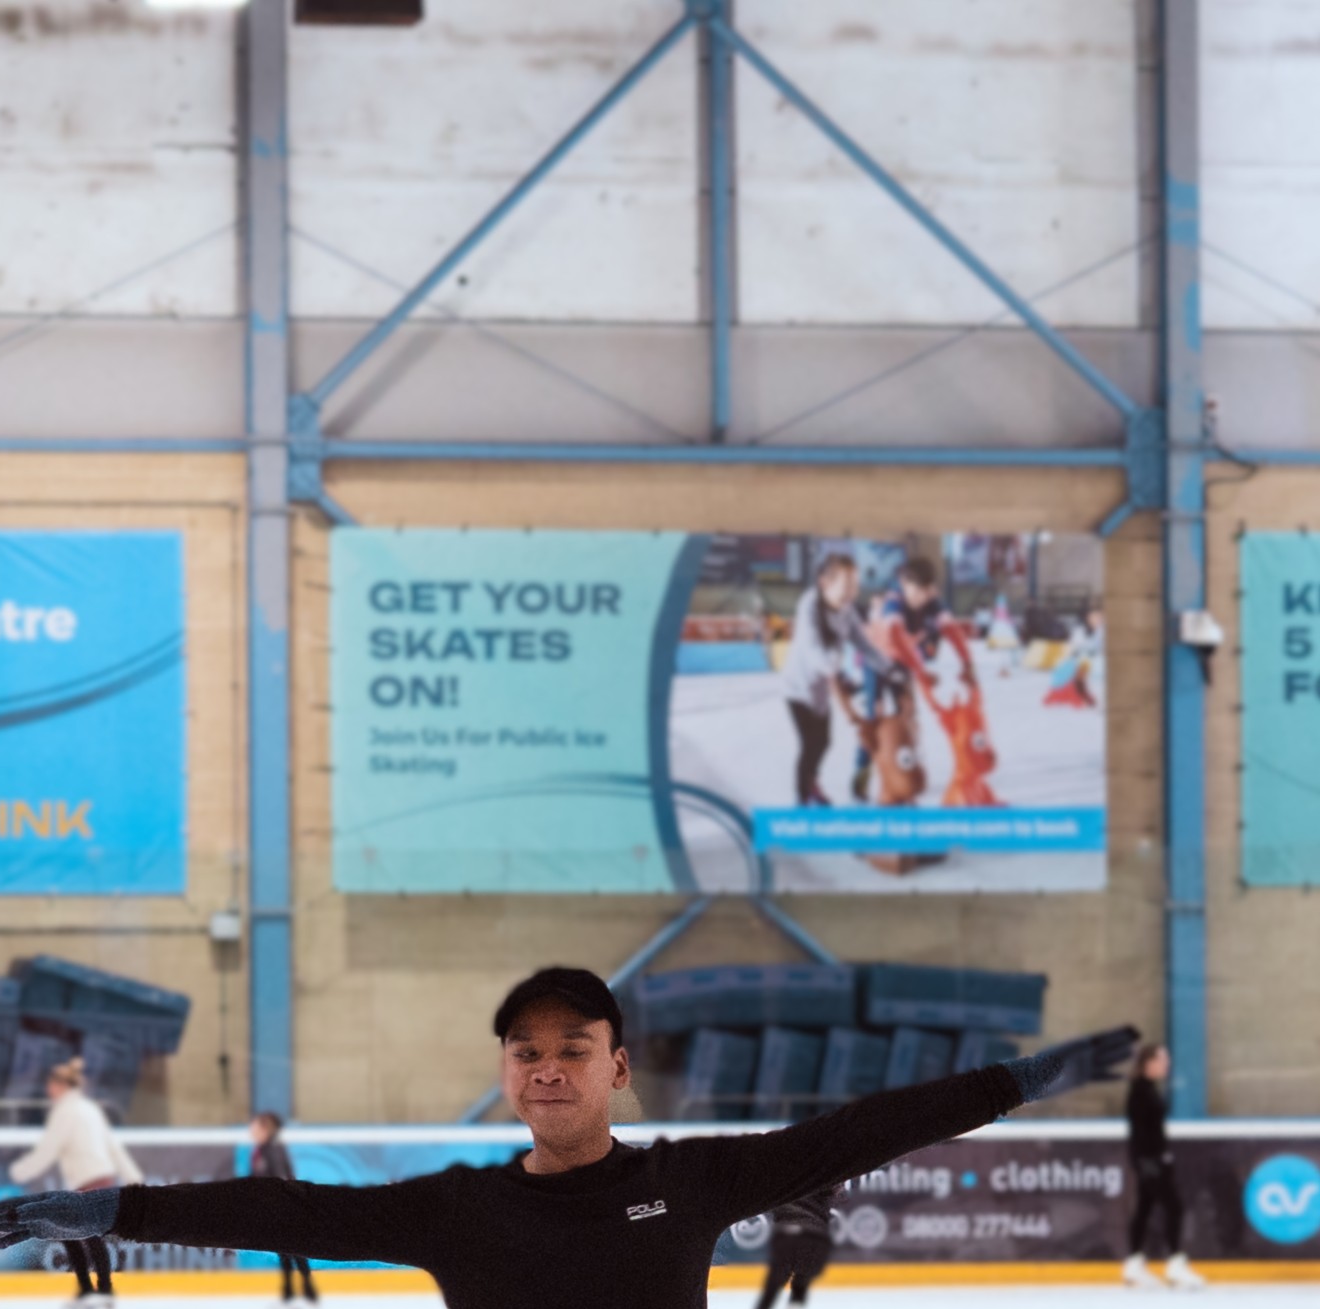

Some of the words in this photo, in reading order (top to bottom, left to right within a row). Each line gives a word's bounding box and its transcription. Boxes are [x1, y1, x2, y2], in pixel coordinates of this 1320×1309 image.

[367, 580, 473, 615] GET
[483, 581, 623, 617] YOUR
[368, 627, 573, 663] SKATES
[1282, 626, 1314, 661] 5
[367, 674, 460, 709] ON!
[498, 727, 568, 749] Public
[574, 729, 607, 749] Ice
[369, 755, 459, 779] Skating
[989, 1157, 1123, 1199] clothing
[626, 1199, 667, 1217] POLO
